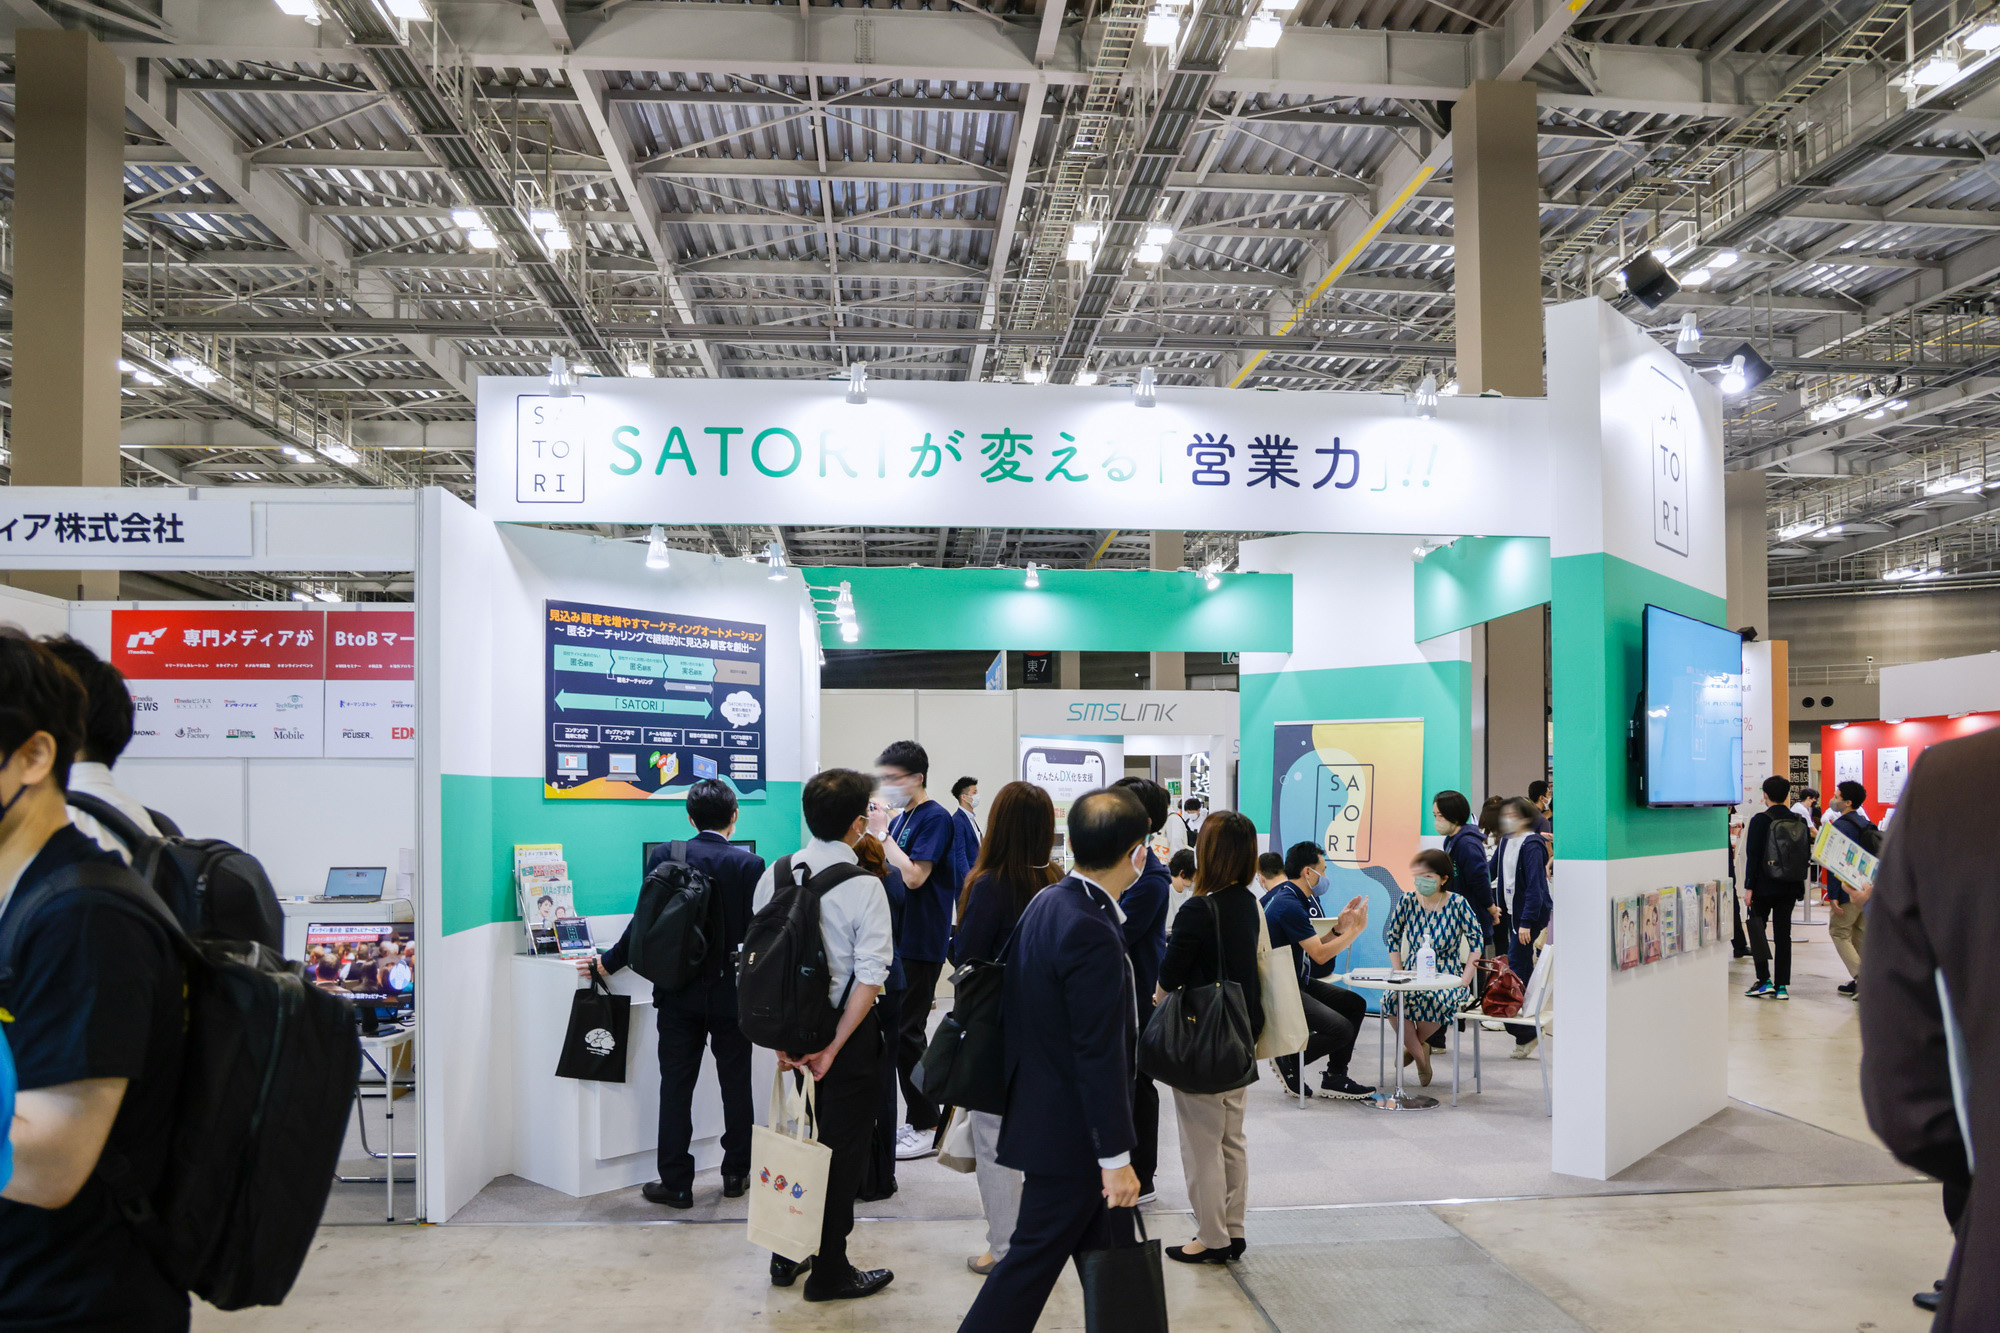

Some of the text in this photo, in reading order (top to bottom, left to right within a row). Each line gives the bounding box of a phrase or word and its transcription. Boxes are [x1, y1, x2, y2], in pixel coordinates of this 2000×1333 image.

[1660, 444, 1680, 482] TO
[534, 474, 565, 492] RI
[1662, 500, 1680, 536] RI
[549, 609, 763, 642] 見込み顧客を増やすマーケティングオートメーション
[183, 629, 314, 647] 専門メディアが
[274, 731, 304, 740] Mobile
[1037, 771, 1093, 782] かんたんDX化を支援
[1331, 775, 1360, 791] SA
[1328, 805, 1360, 821] TO
[1328, 835, 1355, 852] RI
